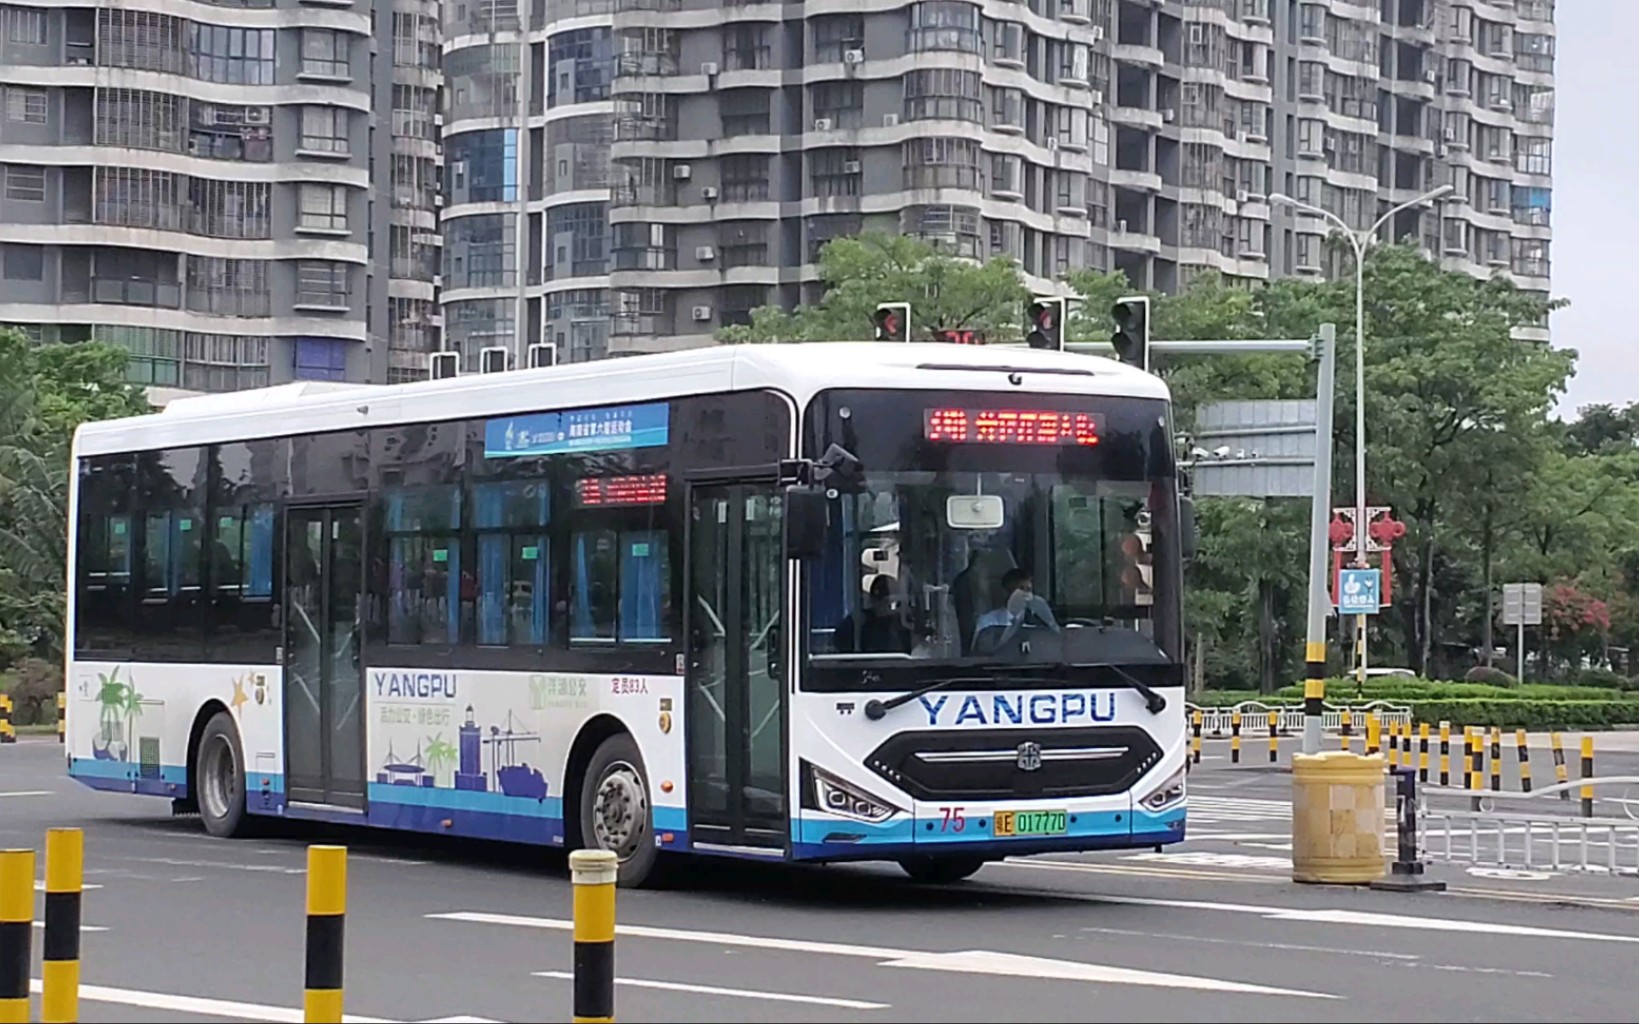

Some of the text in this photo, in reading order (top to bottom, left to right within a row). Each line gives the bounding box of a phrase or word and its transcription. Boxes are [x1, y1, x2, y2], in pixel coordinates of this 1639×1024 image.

[374, 673, 457, 698] YANGPU
[611, 677, 648, 695] 定员83人
[919, 692, 1115, 725] YANGPU
[939, 807, 965, 832] 75
